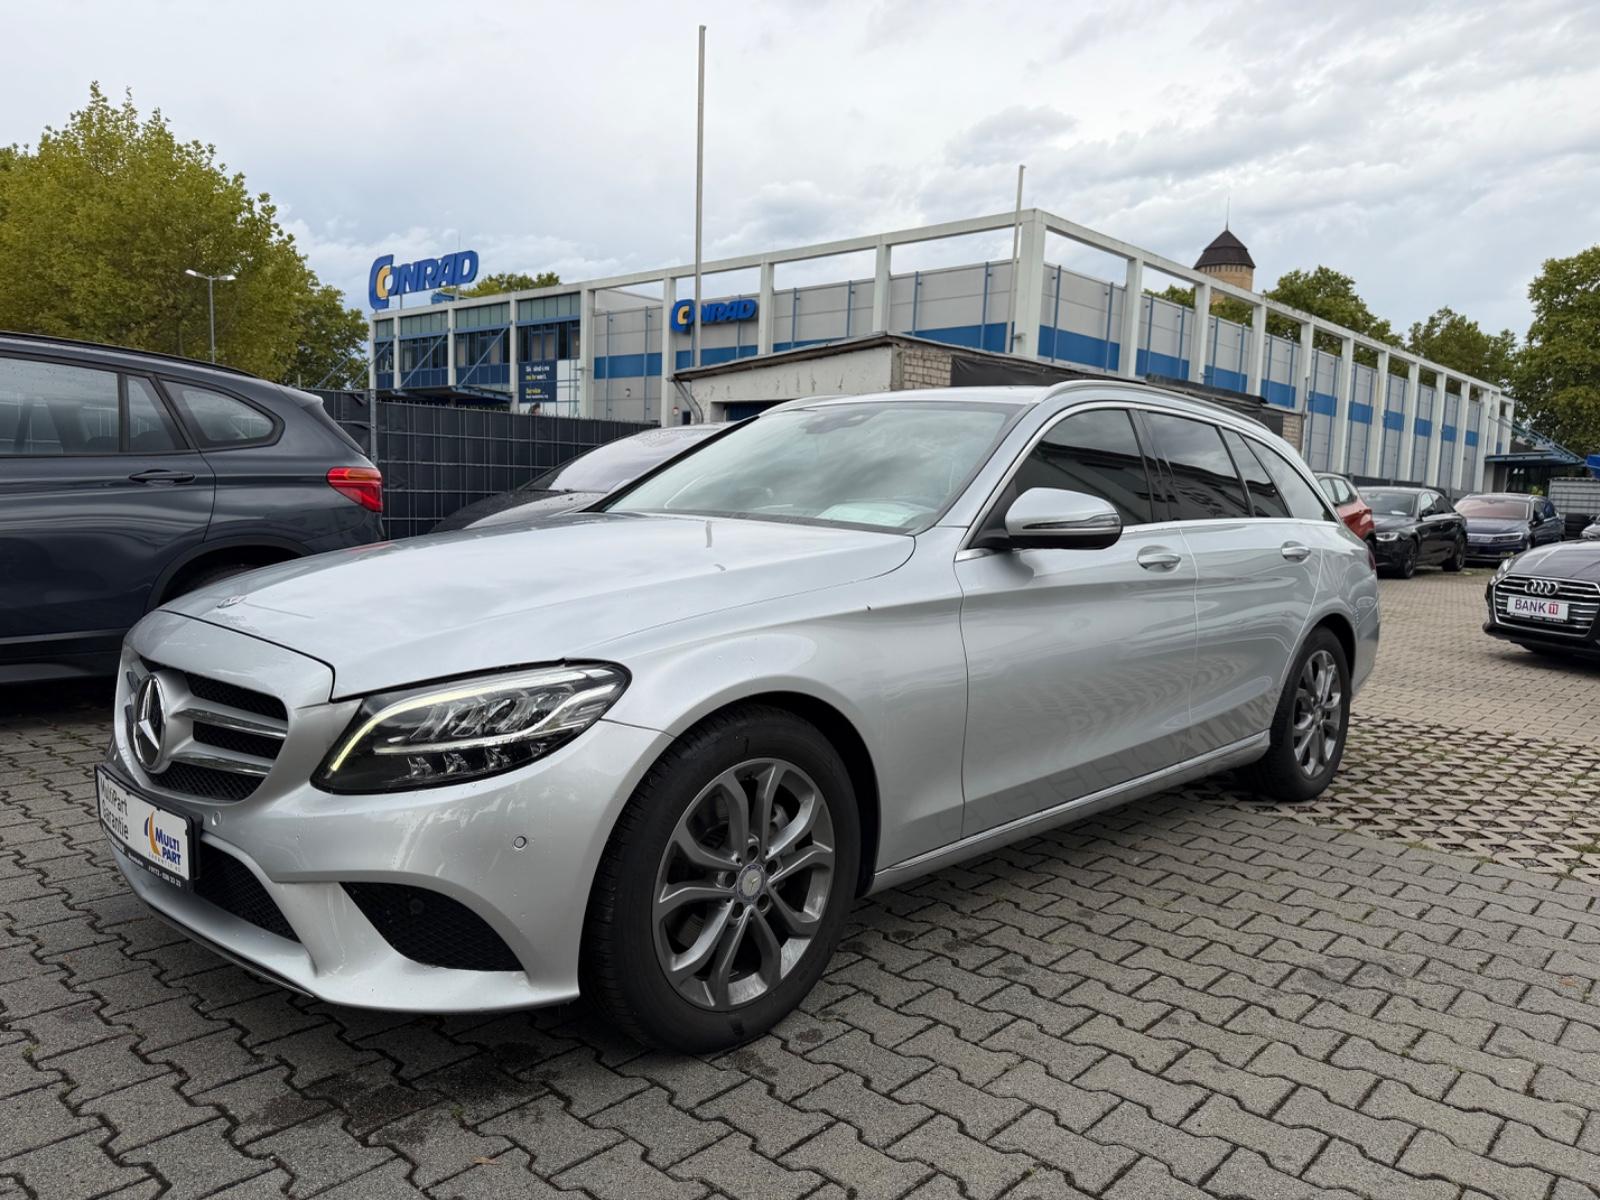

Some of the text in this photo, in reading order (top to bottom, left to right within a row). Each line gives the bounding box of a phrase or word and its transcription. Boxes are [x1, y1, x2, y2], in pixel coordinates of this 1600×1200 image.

[369, 250, 479, 310] CONRAD
[671, 299, 757, 333] CONRAD
[1514, 599, 1546, 614] BANK
[155, 827, 180, 851] MULTI
[162, 846, 181, 865] PART
